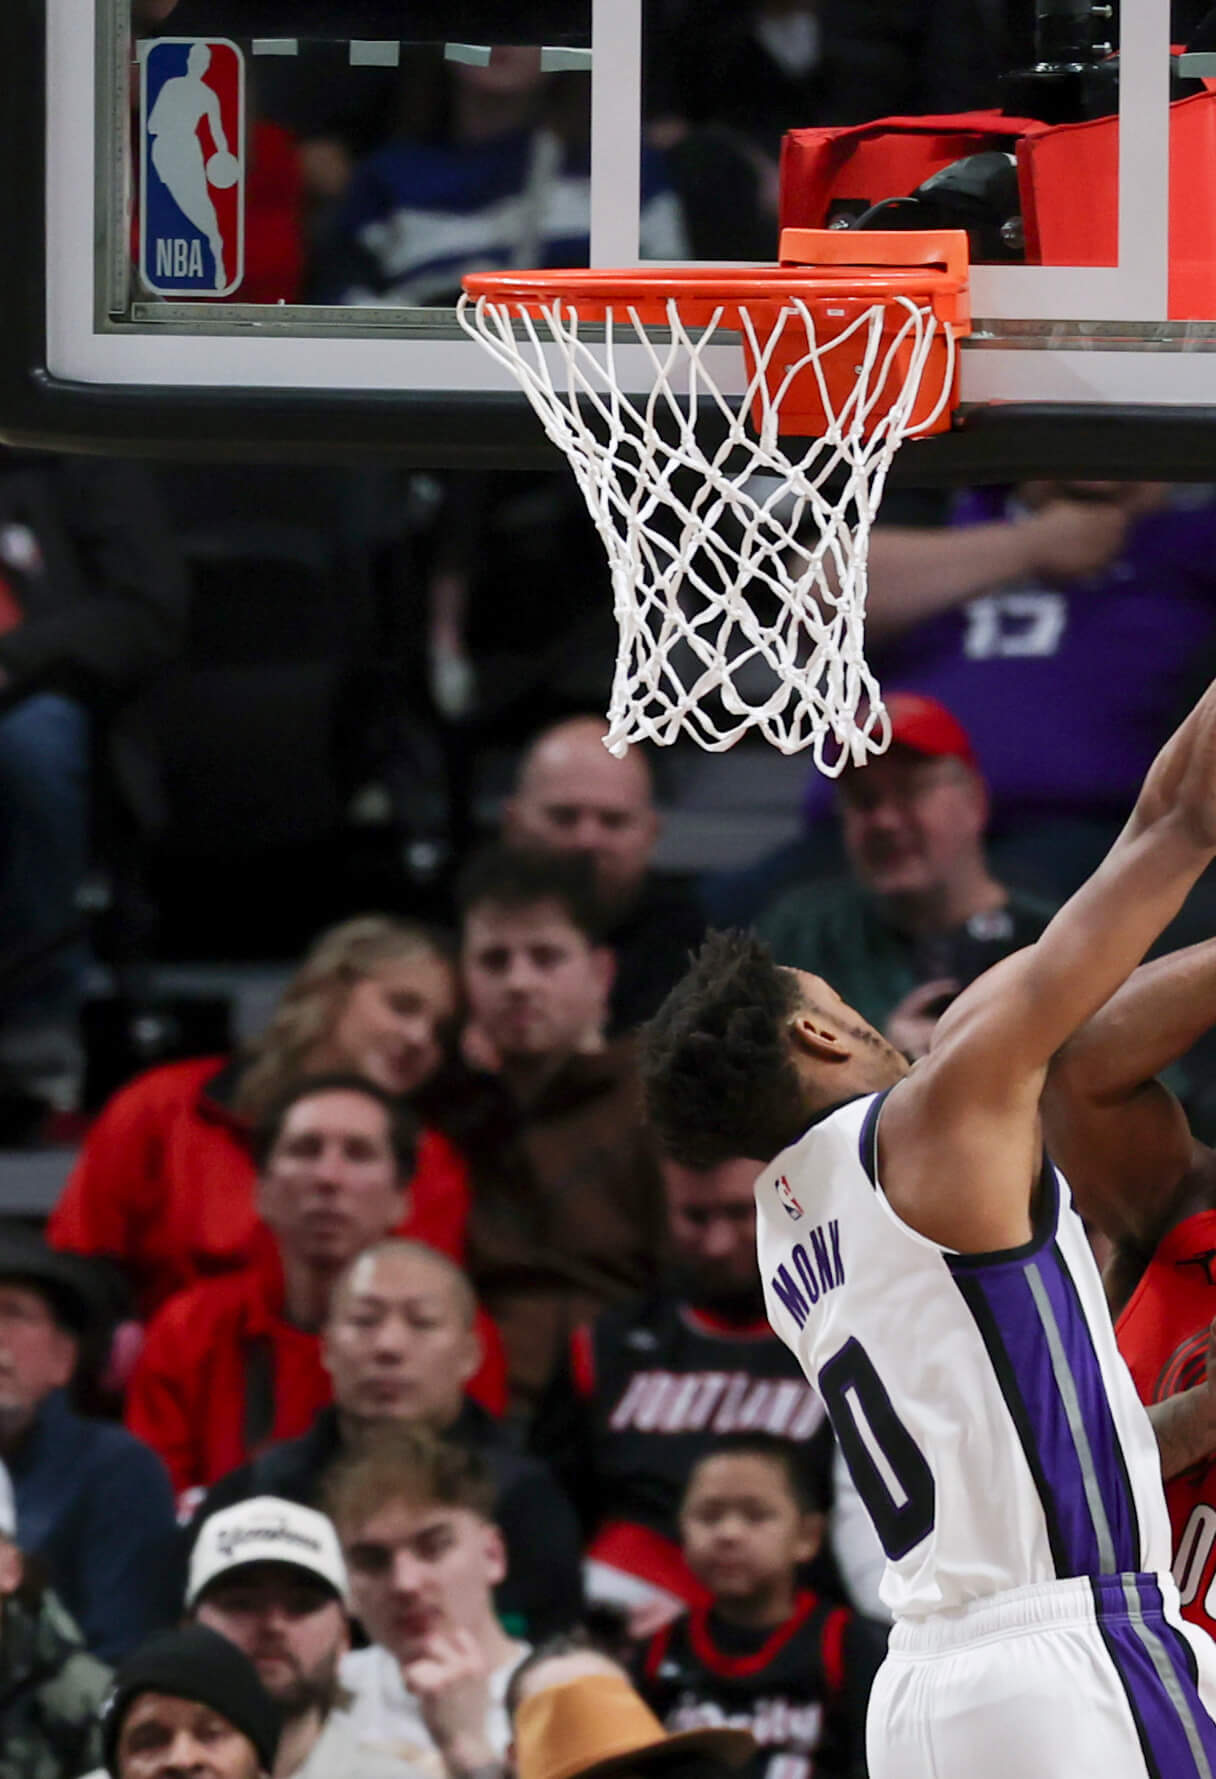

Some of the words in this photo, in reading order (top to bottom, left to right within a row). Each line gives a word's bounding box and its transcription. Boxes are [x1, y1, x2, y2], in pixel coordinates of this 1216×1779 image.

[155, 238, 204, 277] NBA
[772, 1219, 845, 1331] MONK
[818, 1335, 936, 1562] 0
